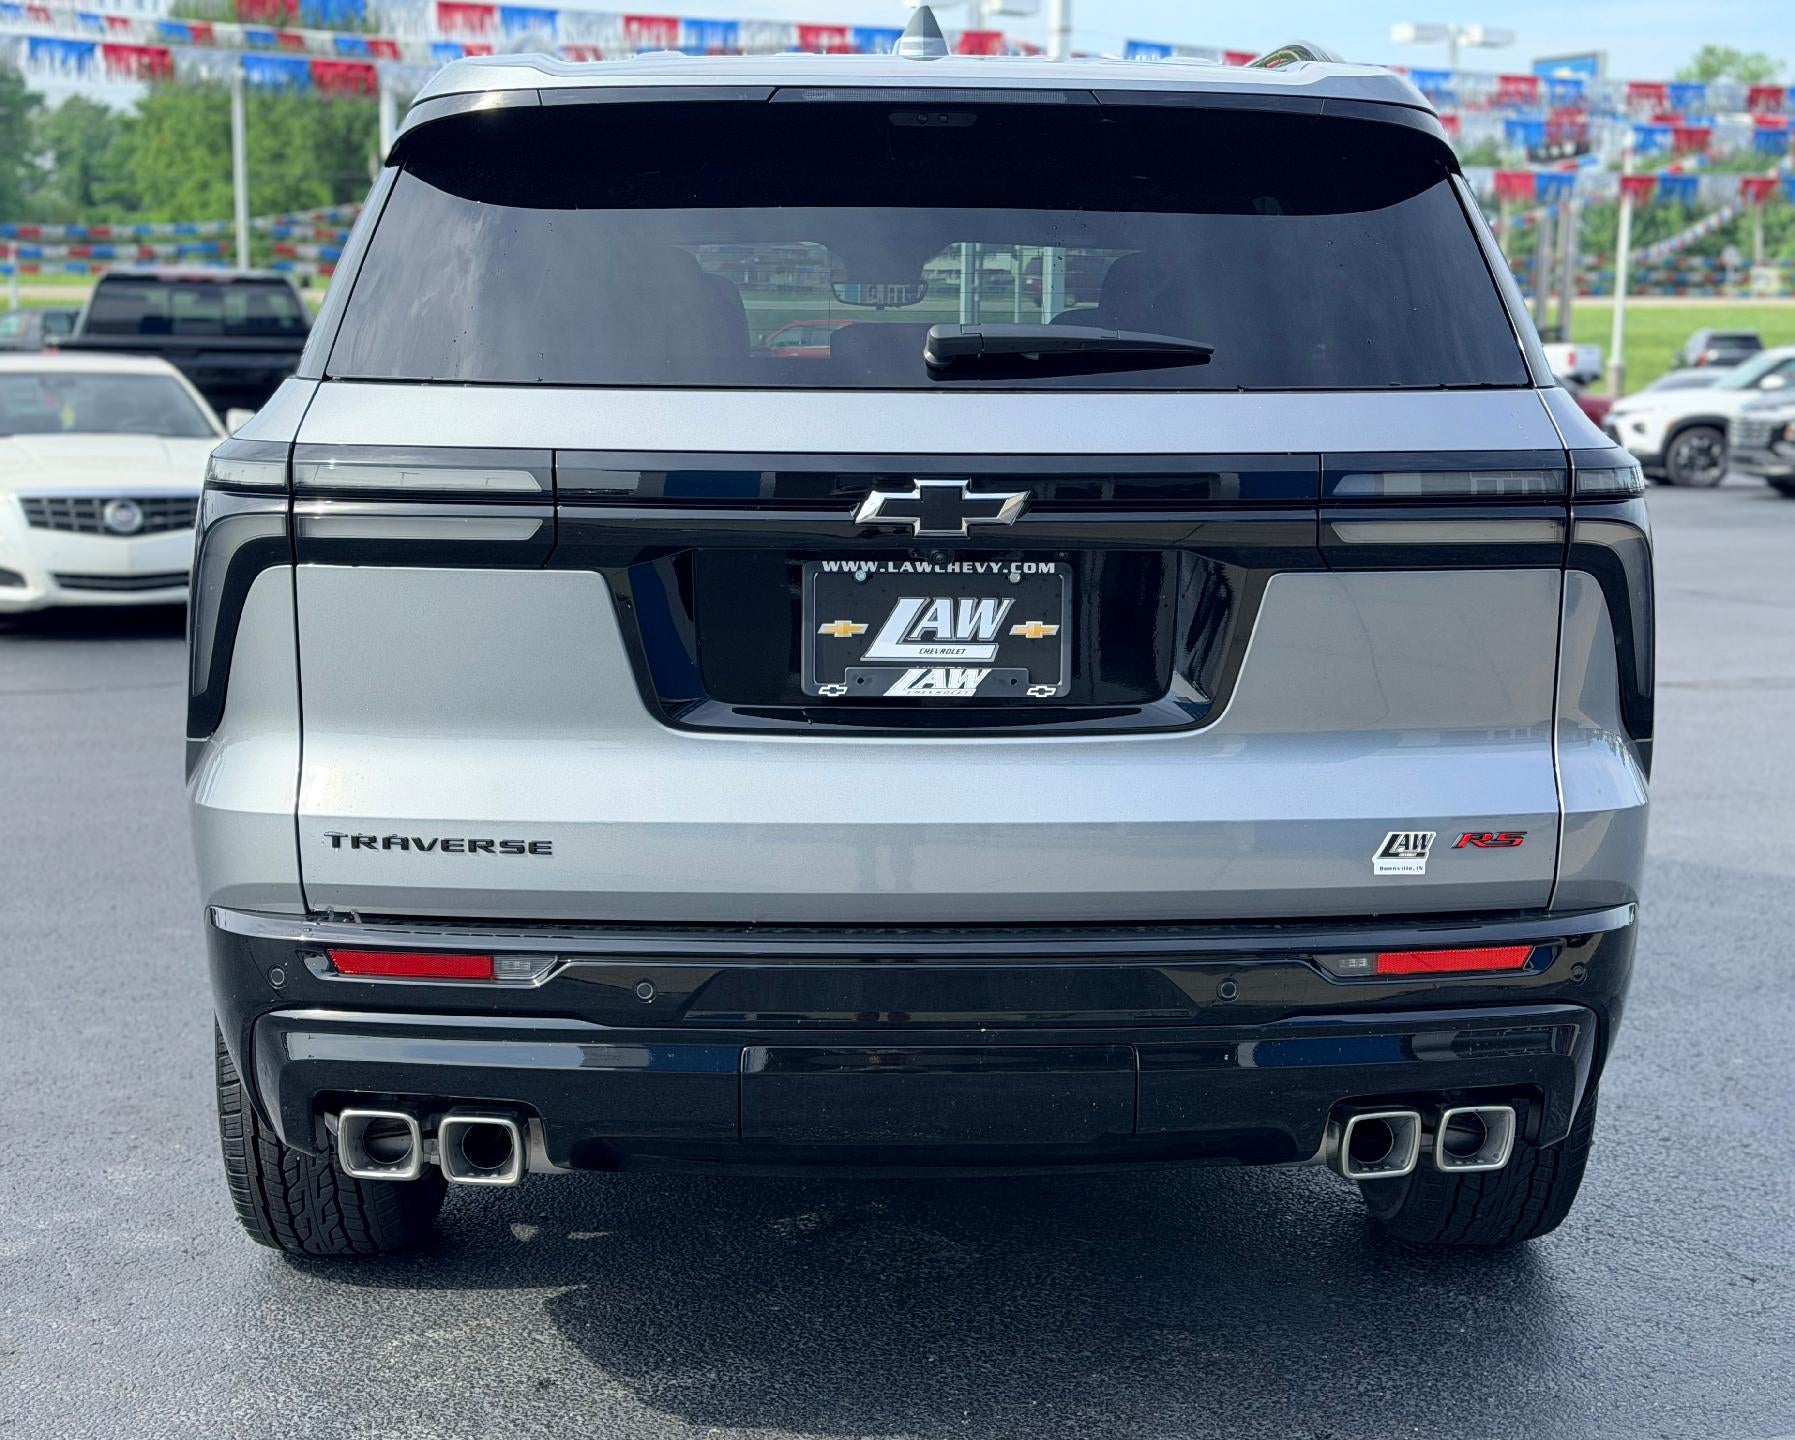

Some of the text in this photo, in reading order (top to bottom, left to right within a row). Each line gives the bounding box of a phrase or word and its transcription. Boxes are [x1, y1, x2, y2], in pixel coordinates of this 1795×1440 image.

[860, 597, 1015, 662] LAW
[919, 647, 967, 655] CHEVROLET
[883, 668, 992, 697] LAW
[324, 831, 553, 855] TRAVERSE
[1376, 833, 1434, 858] LAW
[1450, 831, 1527, 849] RS
